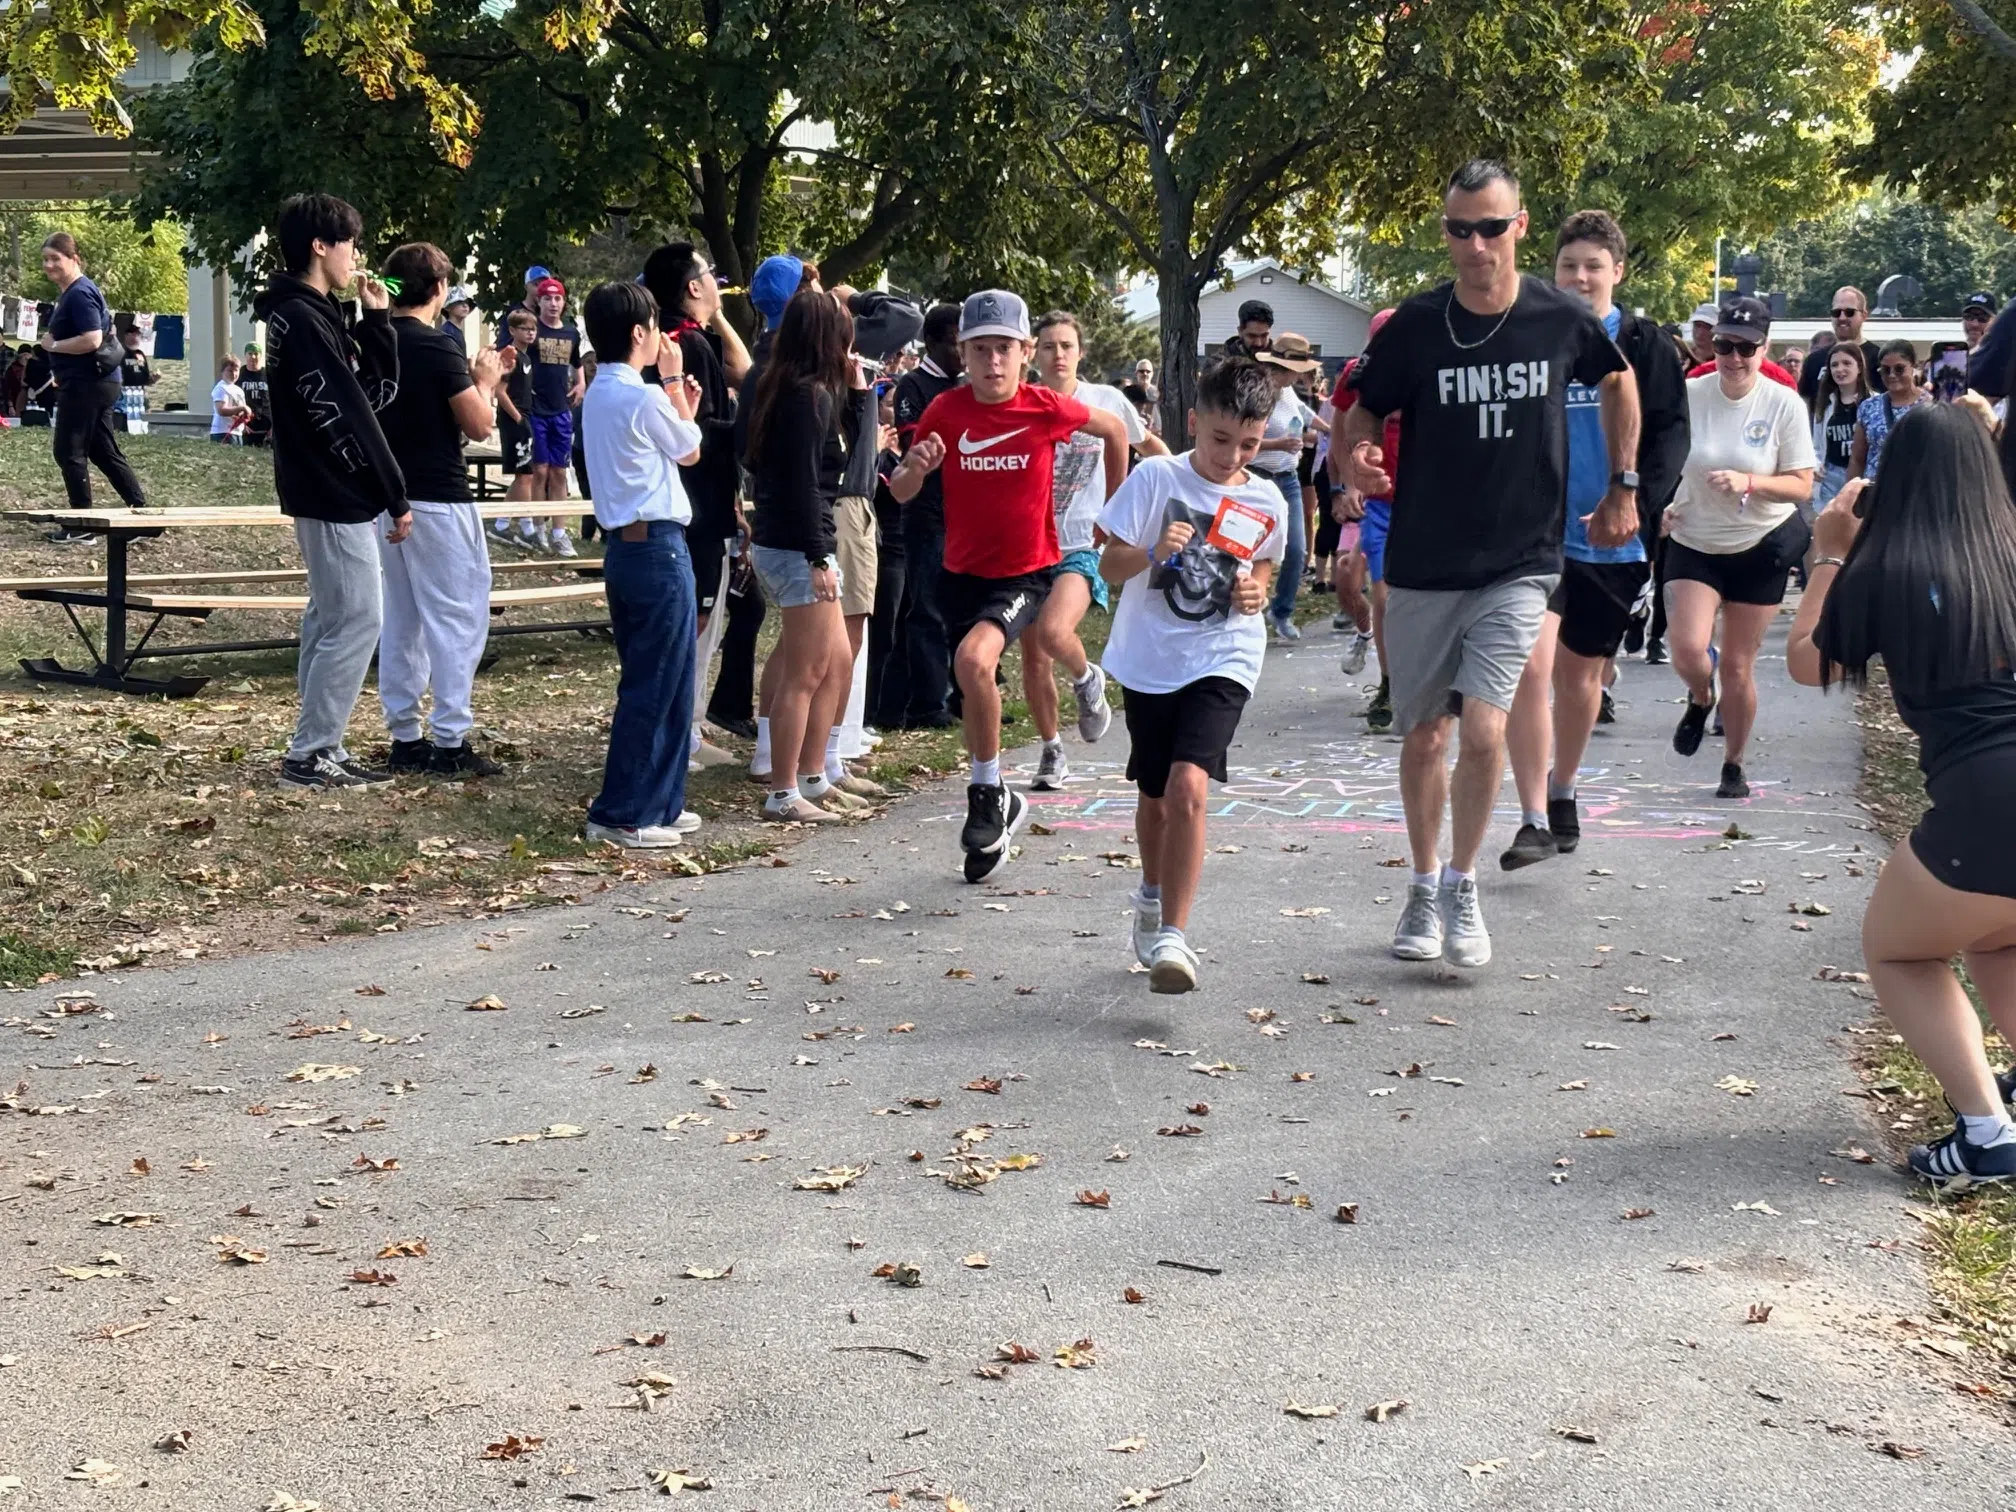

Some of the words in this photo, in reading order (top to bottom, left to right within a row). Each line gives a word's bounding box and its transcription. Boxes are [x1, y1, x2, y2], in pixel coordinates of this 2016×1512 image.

[1437, 360, 1549, 405] FINISH
[1478, 403, 1514, 439] IT.
[960, 454, 1031, 471] HOCKEY
